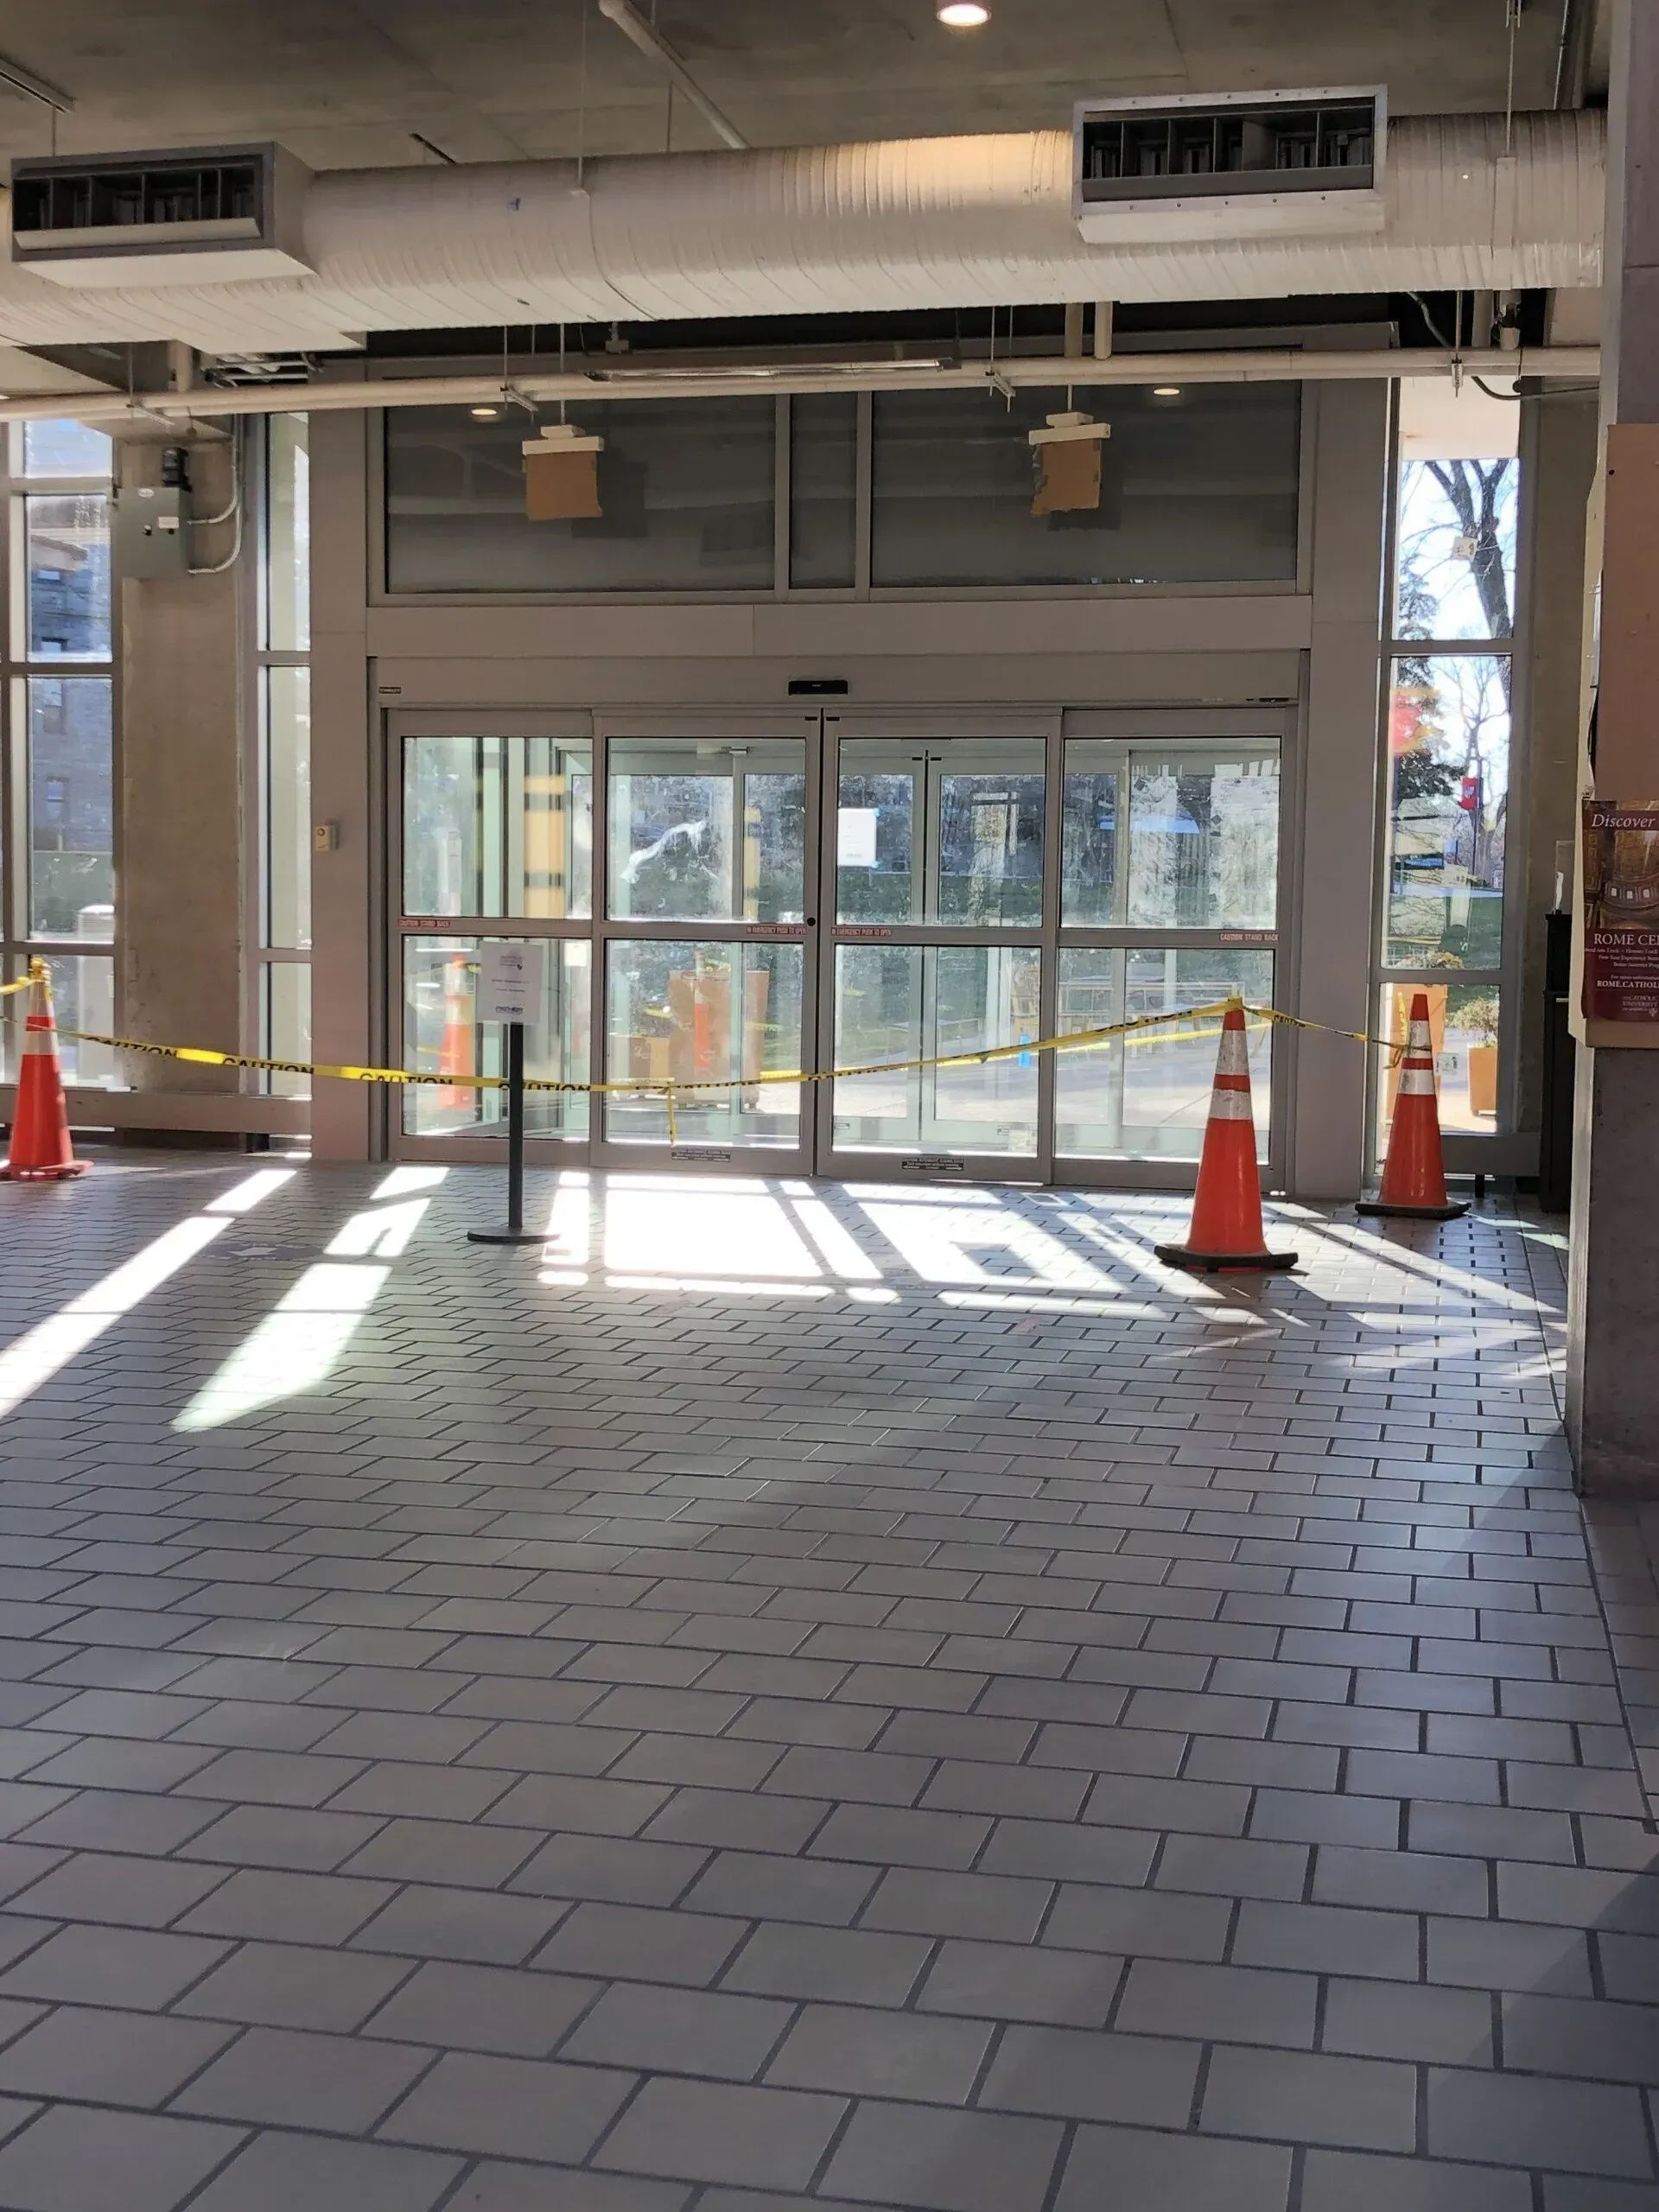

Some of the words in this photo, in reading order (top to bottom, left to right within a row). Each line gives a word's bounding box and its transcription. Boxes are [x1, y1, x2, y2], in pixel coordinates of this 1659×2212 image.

[1592, 814, 1656, 828] Discover
[1594, 933, 1635, 945] ROME
[1637, 934, 1659, 946] CE
